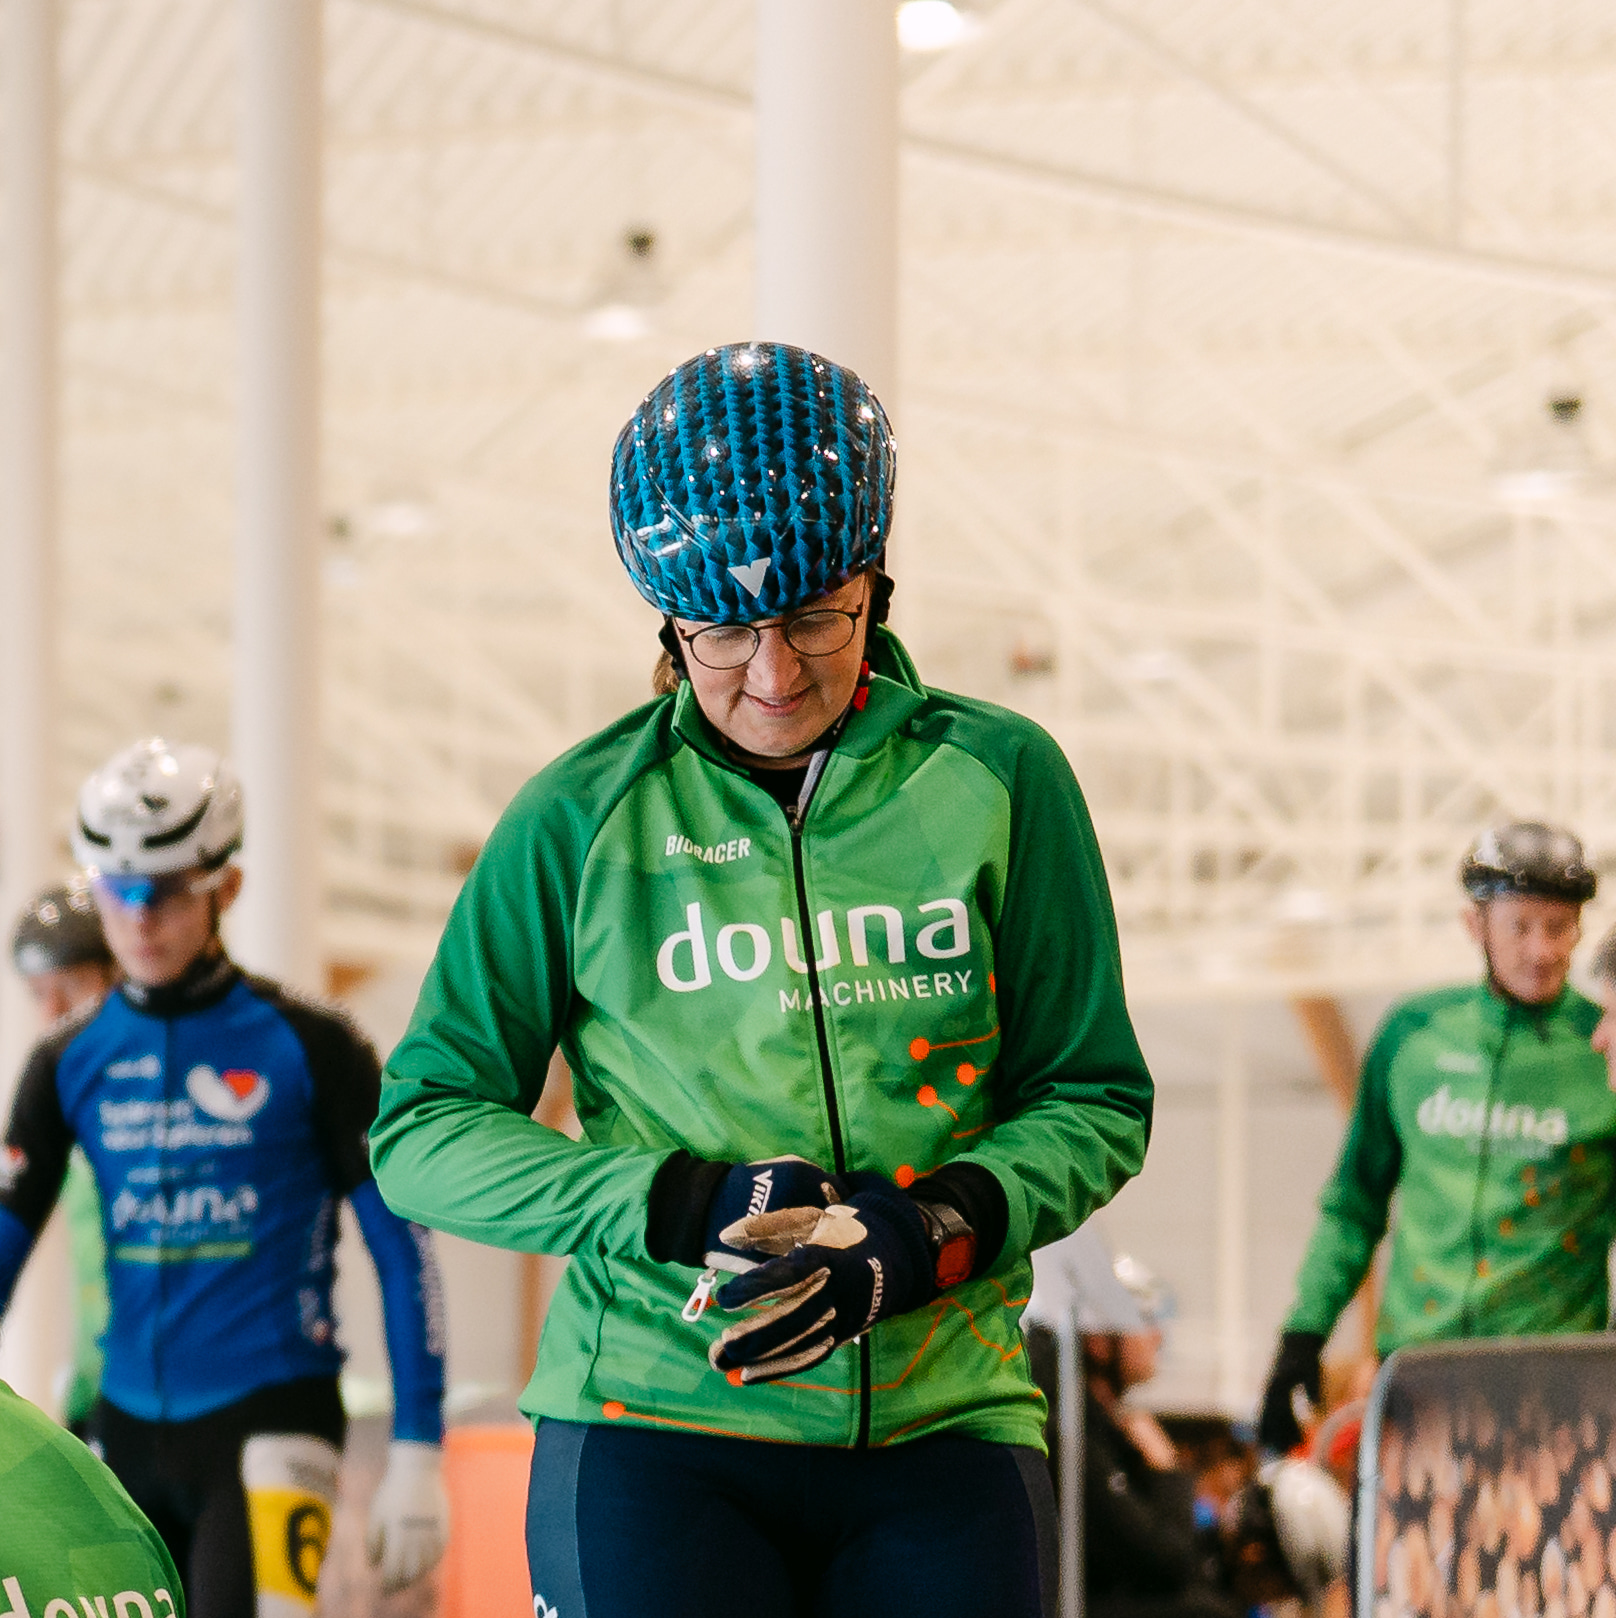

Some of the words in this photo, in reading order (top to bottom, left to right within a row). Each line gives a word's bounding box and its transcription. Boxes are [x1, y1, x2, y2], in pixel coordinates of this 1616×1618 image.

[655, 897, 972, 993] douna
[778, 969, 973, 1013] MACHINERY
[746, 1169, 774, 1217] VIKI
